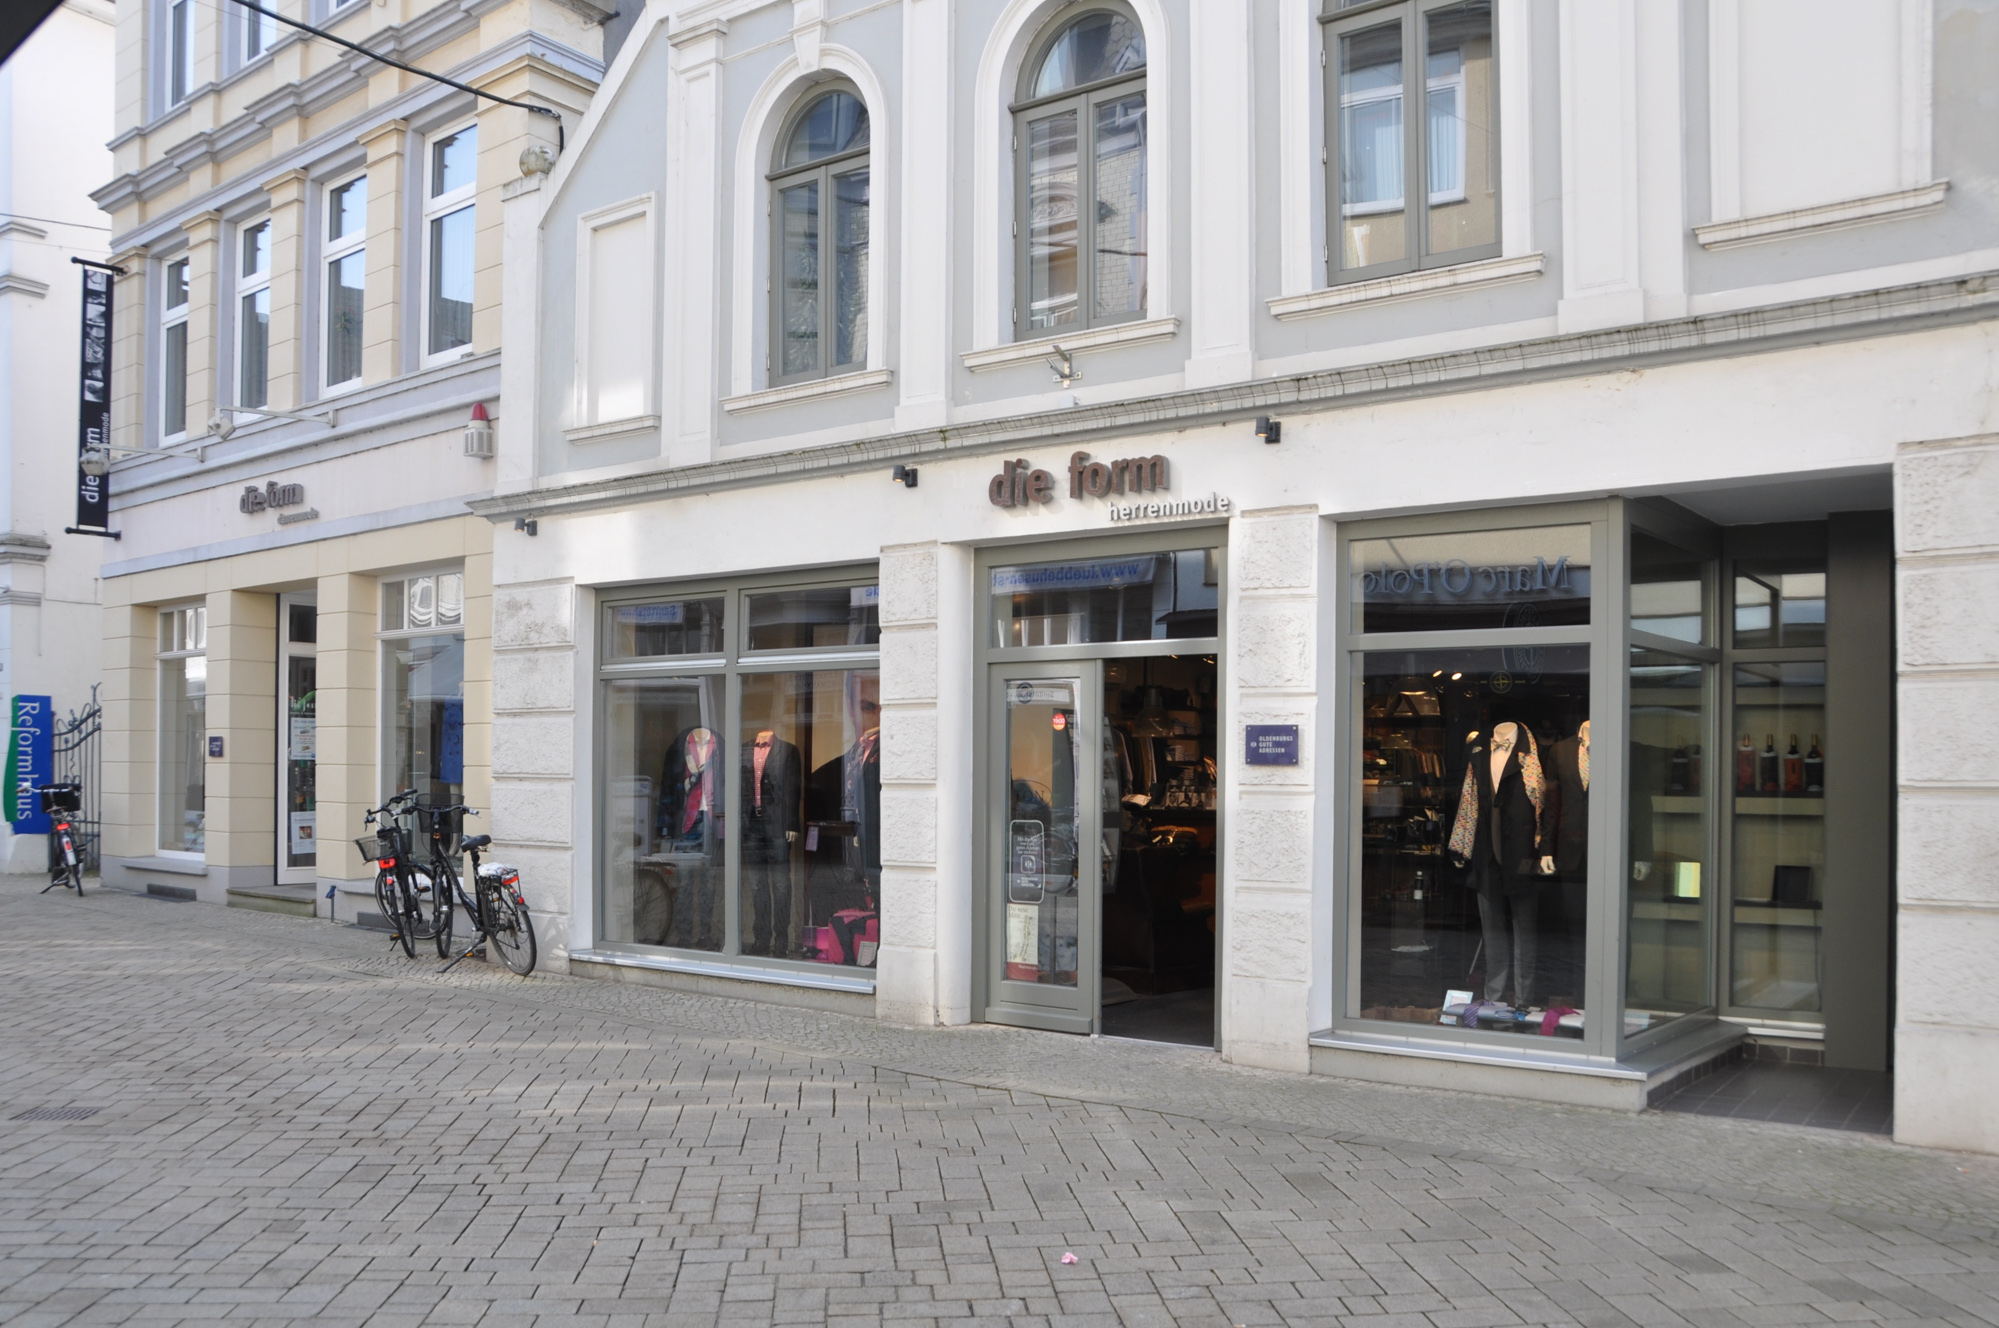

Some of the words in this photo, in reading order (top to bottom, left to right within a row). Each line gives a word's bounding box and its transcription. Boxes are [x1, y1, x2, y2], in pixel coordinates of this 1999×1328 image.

[81, 475, 100, 503] die
[988, 458, 1055, 508] die
[1068, 450, 1170, 500] form
[240, 485, 267, 514] die
[266, 480, 304, 508] form
[1108, 492, 1231, 521] herrenmode
